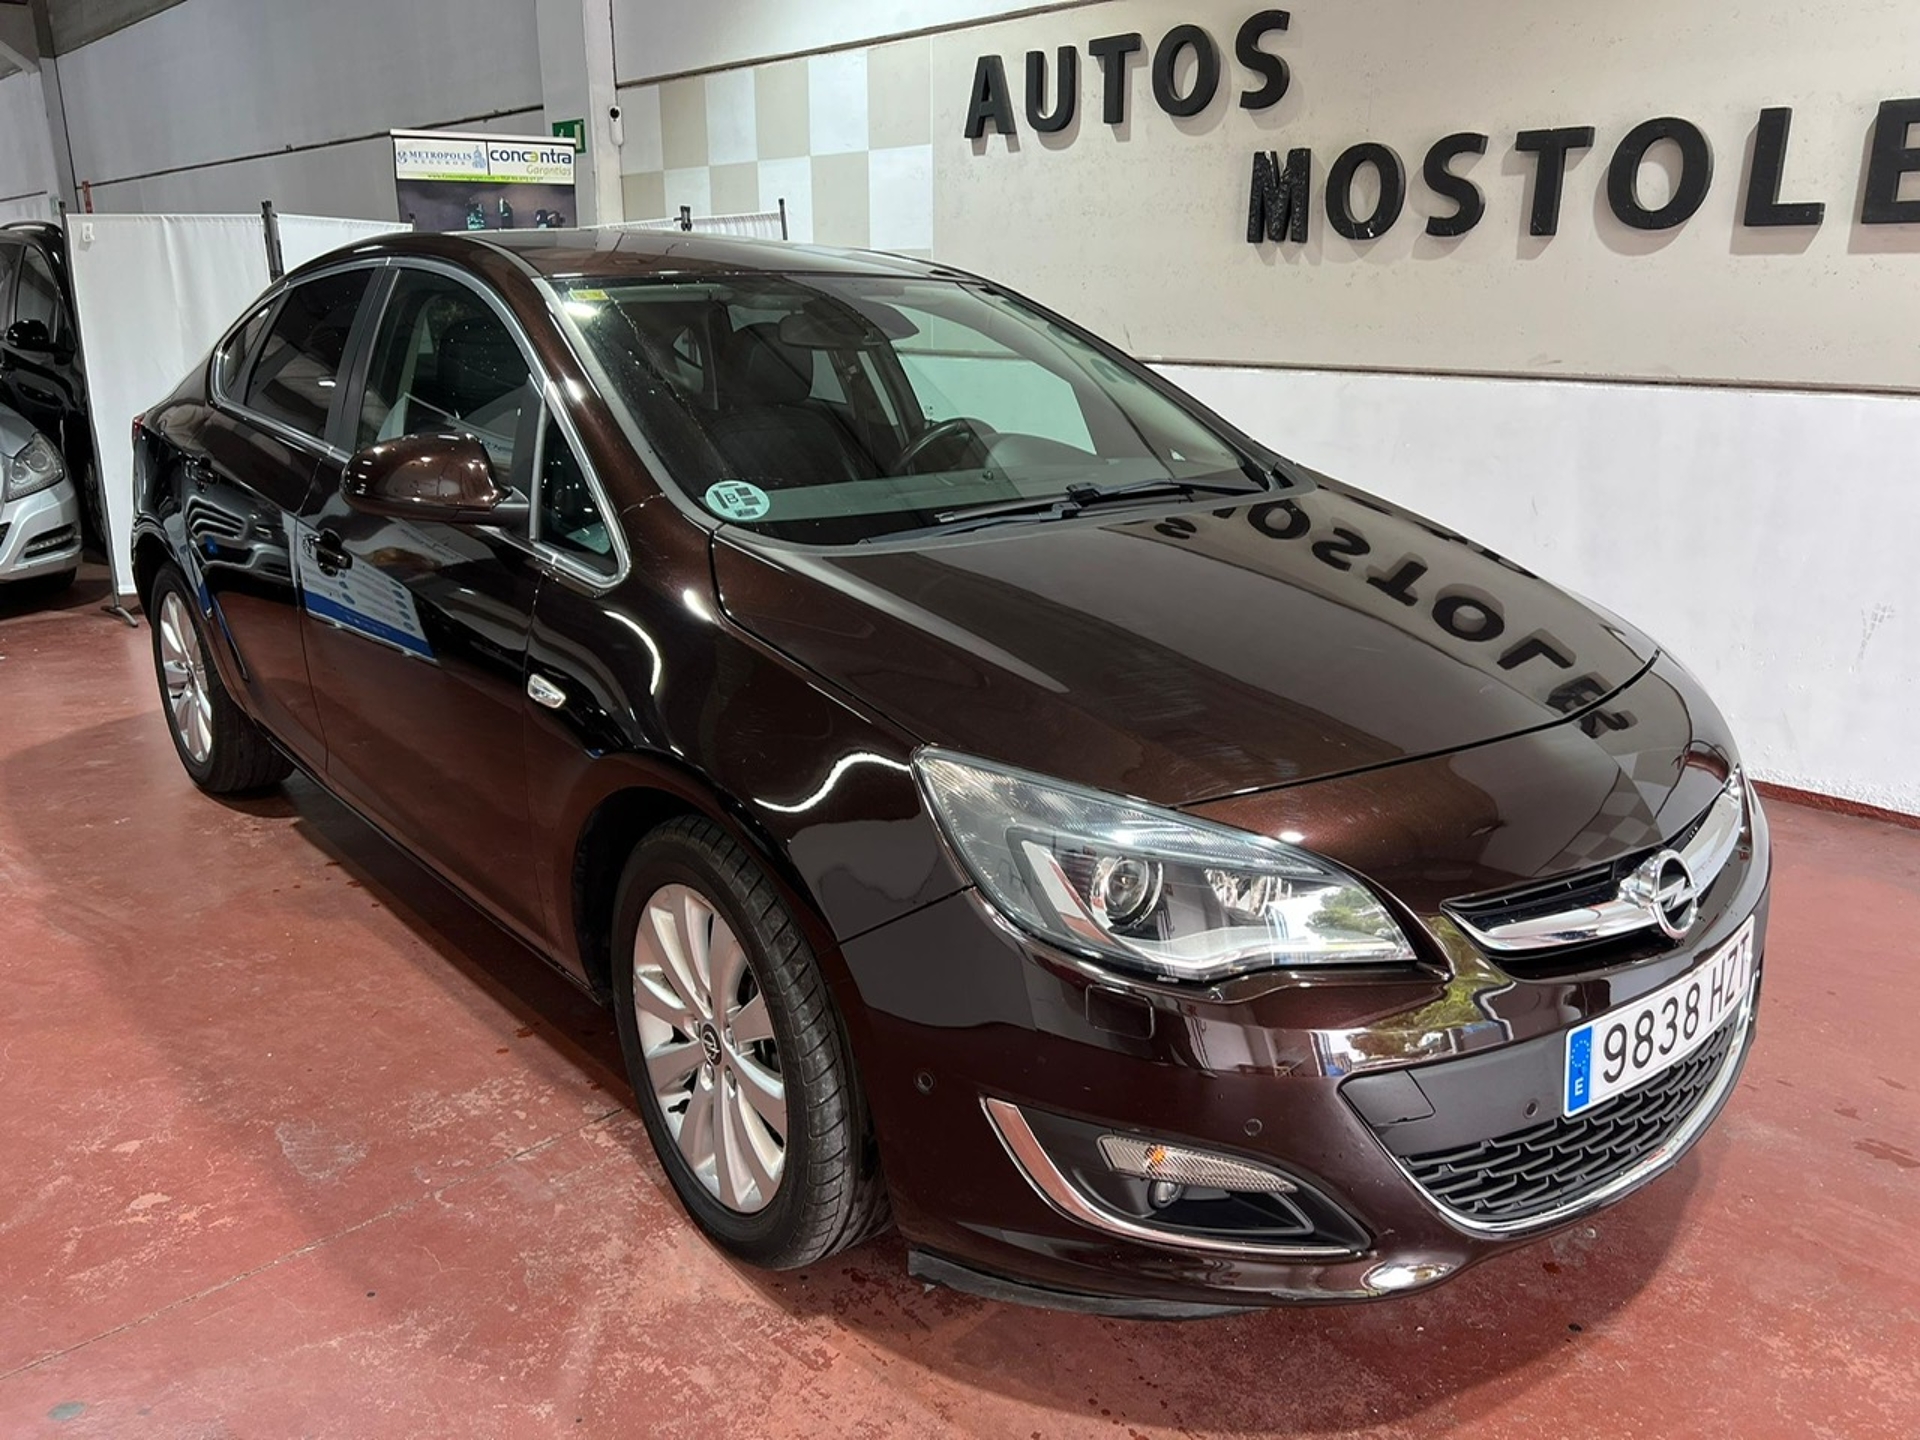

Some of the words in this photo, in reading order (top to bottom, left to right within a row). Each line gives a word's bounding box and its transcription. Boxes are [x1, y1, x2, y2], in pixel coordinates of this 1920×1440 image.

[964, 10, 1291, 140] AUTOS
[409, 150, 472, 160] METROPOLIS
[489, 148, 572, 164] concentra
[1246, 97, 1920, 244] MOSTOLE
[1574, 1077, 1584, 1096] E
[1603, 982, 1700, 1083] 9838
[1709, 932, 1750, 1023] HZT
